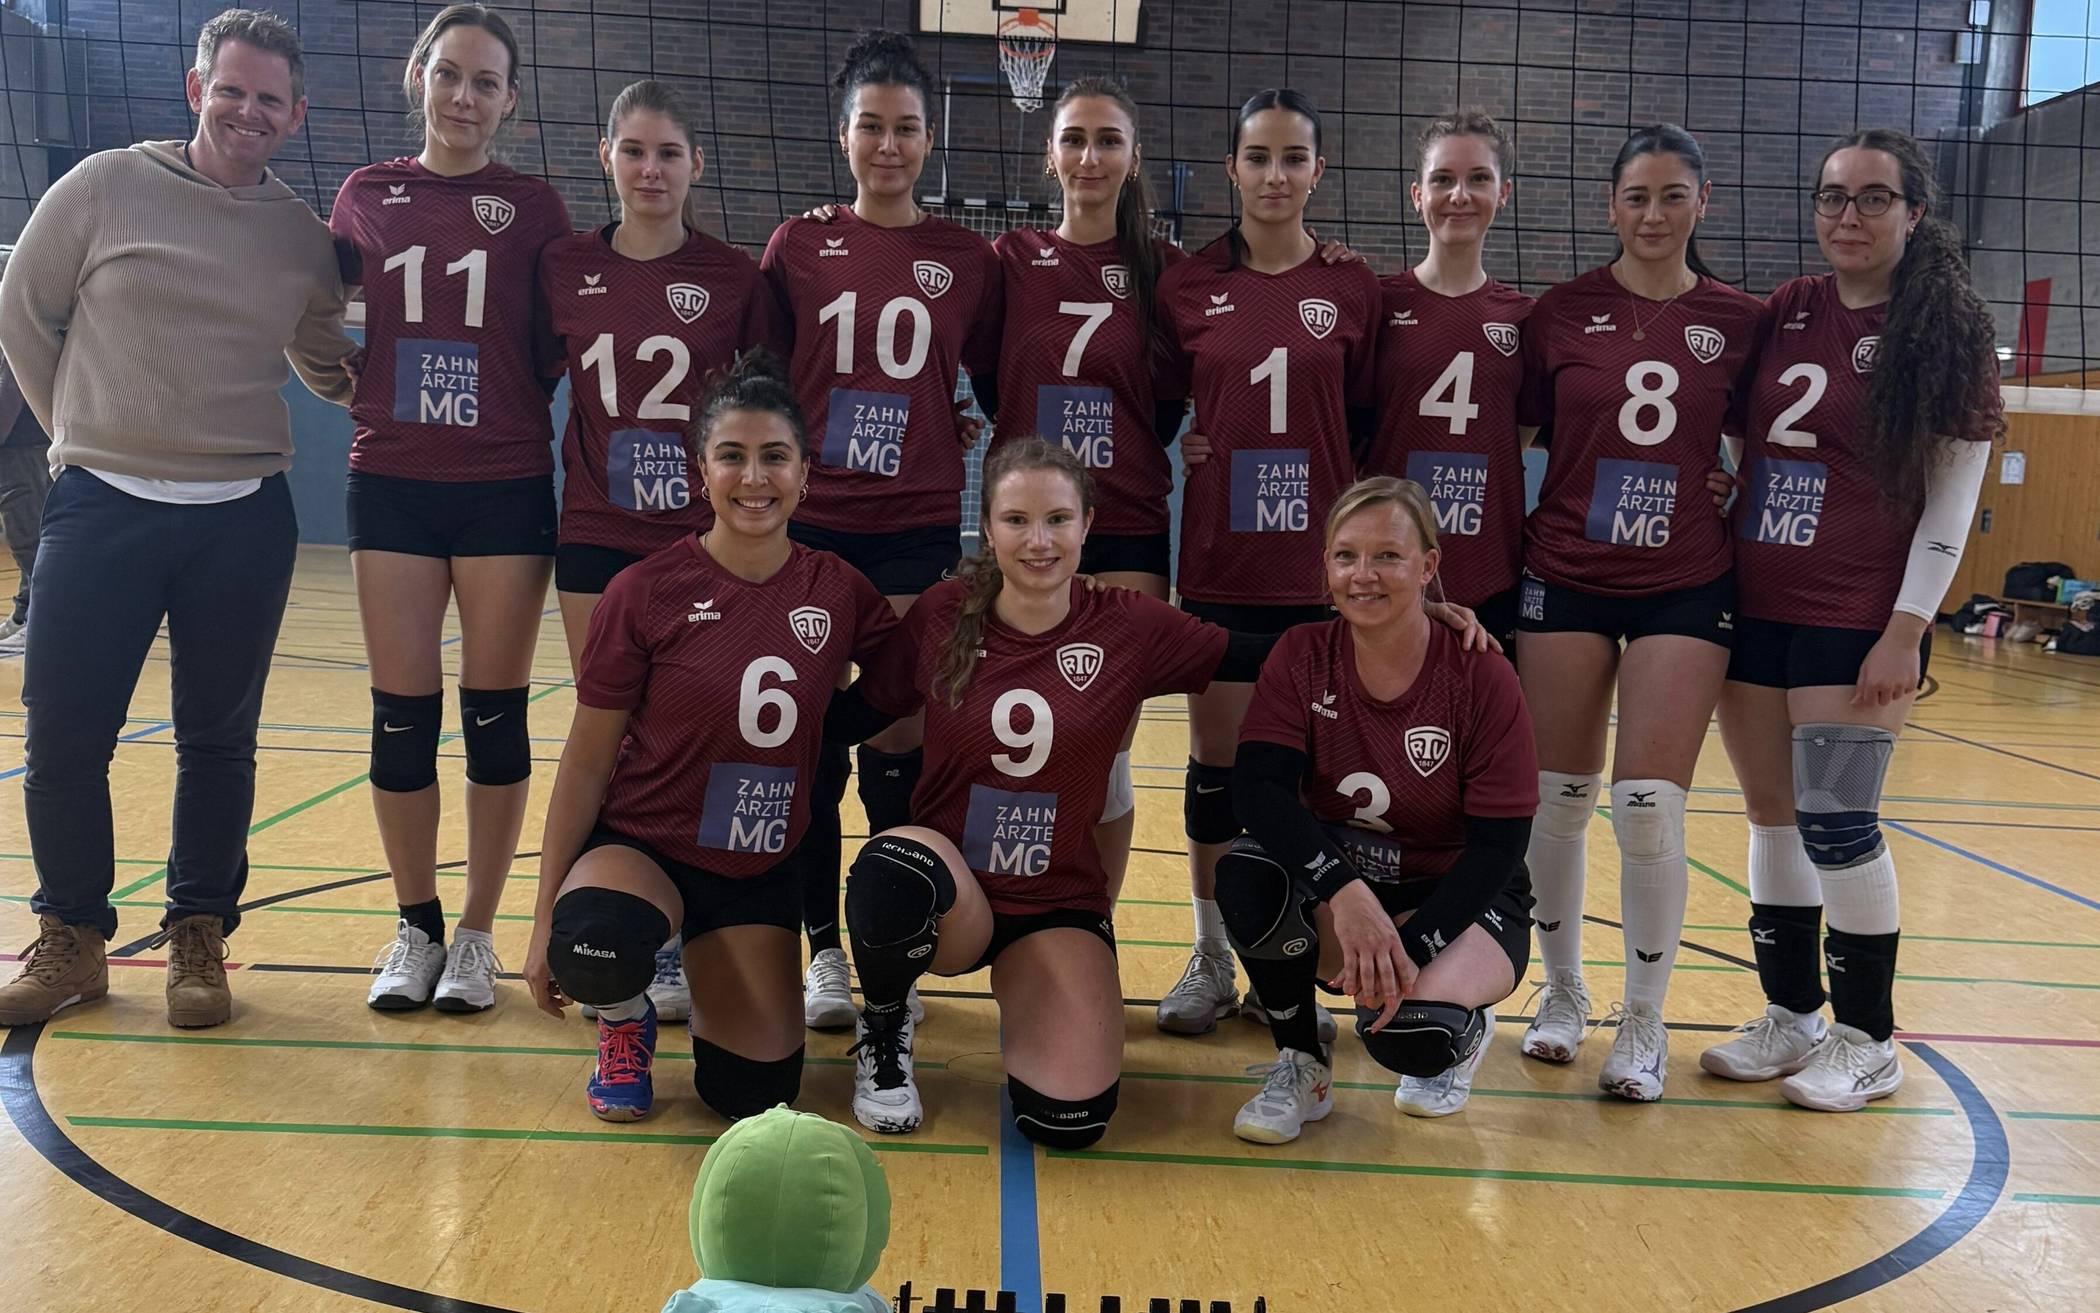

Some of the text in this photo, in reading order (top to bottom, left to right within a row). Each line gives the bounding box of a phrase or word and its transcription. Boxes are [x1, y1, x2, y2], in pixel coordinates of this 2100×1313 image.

[382, 196, 411, 205] erima
[819, 249, 849, 257] erima
[1031, 258, 1059, 266] erima
[383, 245, 488, 328] 11
[578, 286, 607, 296] erima
[1205, 304, 1235, 317] erima
[819, 291, 932, 380] 10
[1058, 301, 1113, 378] 7
[1584, 324, 1617, 334] erima
[421, 353, 479, 373] ZAHN
[421, 370, 479, 392] ÄRZTE
[581, 333, 690, 422] 12
[1250, 347, 1288, 434] 1
[1418, 351, 1479, 436] 4
[420, 391, 479, 427] MG
[854, 404, 909, 425] ZAHN
[1063, 401, 1113, 416] ZAHN
[1617, 361, 1680, 446] 8
[1766, 363, 1828, 449] 2
[851, 420, 906, 443] ÄRZTE
[1062, 416, 1113, 434] ÄRZTE
[633, 443, 687, 459] ZAHN
[846, 439, 901, 477] MG
[1062, 435, 1113, 469] MG
[633, 456, 688, 475] ÄRZTE
[1257, 464, 1310, 479] ZAHN
[1432, 466, 1488, 483] ZAHN
[633, 477, 690, 511] MG
[1257, 478, 1309, 497] ÄRZTE
[1430, 480, 1486, 502] ÄRZTE
[1620, 475, 1677, 496] ZAHN
[1768, 472, 1826, 493] ZAHN
[1617, 490, 1675, 515] ÄRZTE
[1764, 487, 1824, 514] ÄRZTE
[1256, 499, 1309, 532] MG
[1430, 501, 1484, 536] MG
[1610, 514, 1670, 548] MG
[1757, 510, 1819, 547] MG
[688, 611, 721, 622] erima
[1522, 604, 1544, 621] MG
[739, 655, 798, 748] 6
[990, 688, 1054, 778] 9
[737, 779, 795, 799] ZAHN
[734, 794, 791, 817] ÄRZTE
[1335, 771, 1394, 834] 3
[997, 806, 1056, 823] ZAHN
[727, 816, 787, 854] MG
[994, 820, 1054, 842] ÄRZTE
[988, 843, 1051, 877] MG
[1312, 857, 1340, 882] erima
